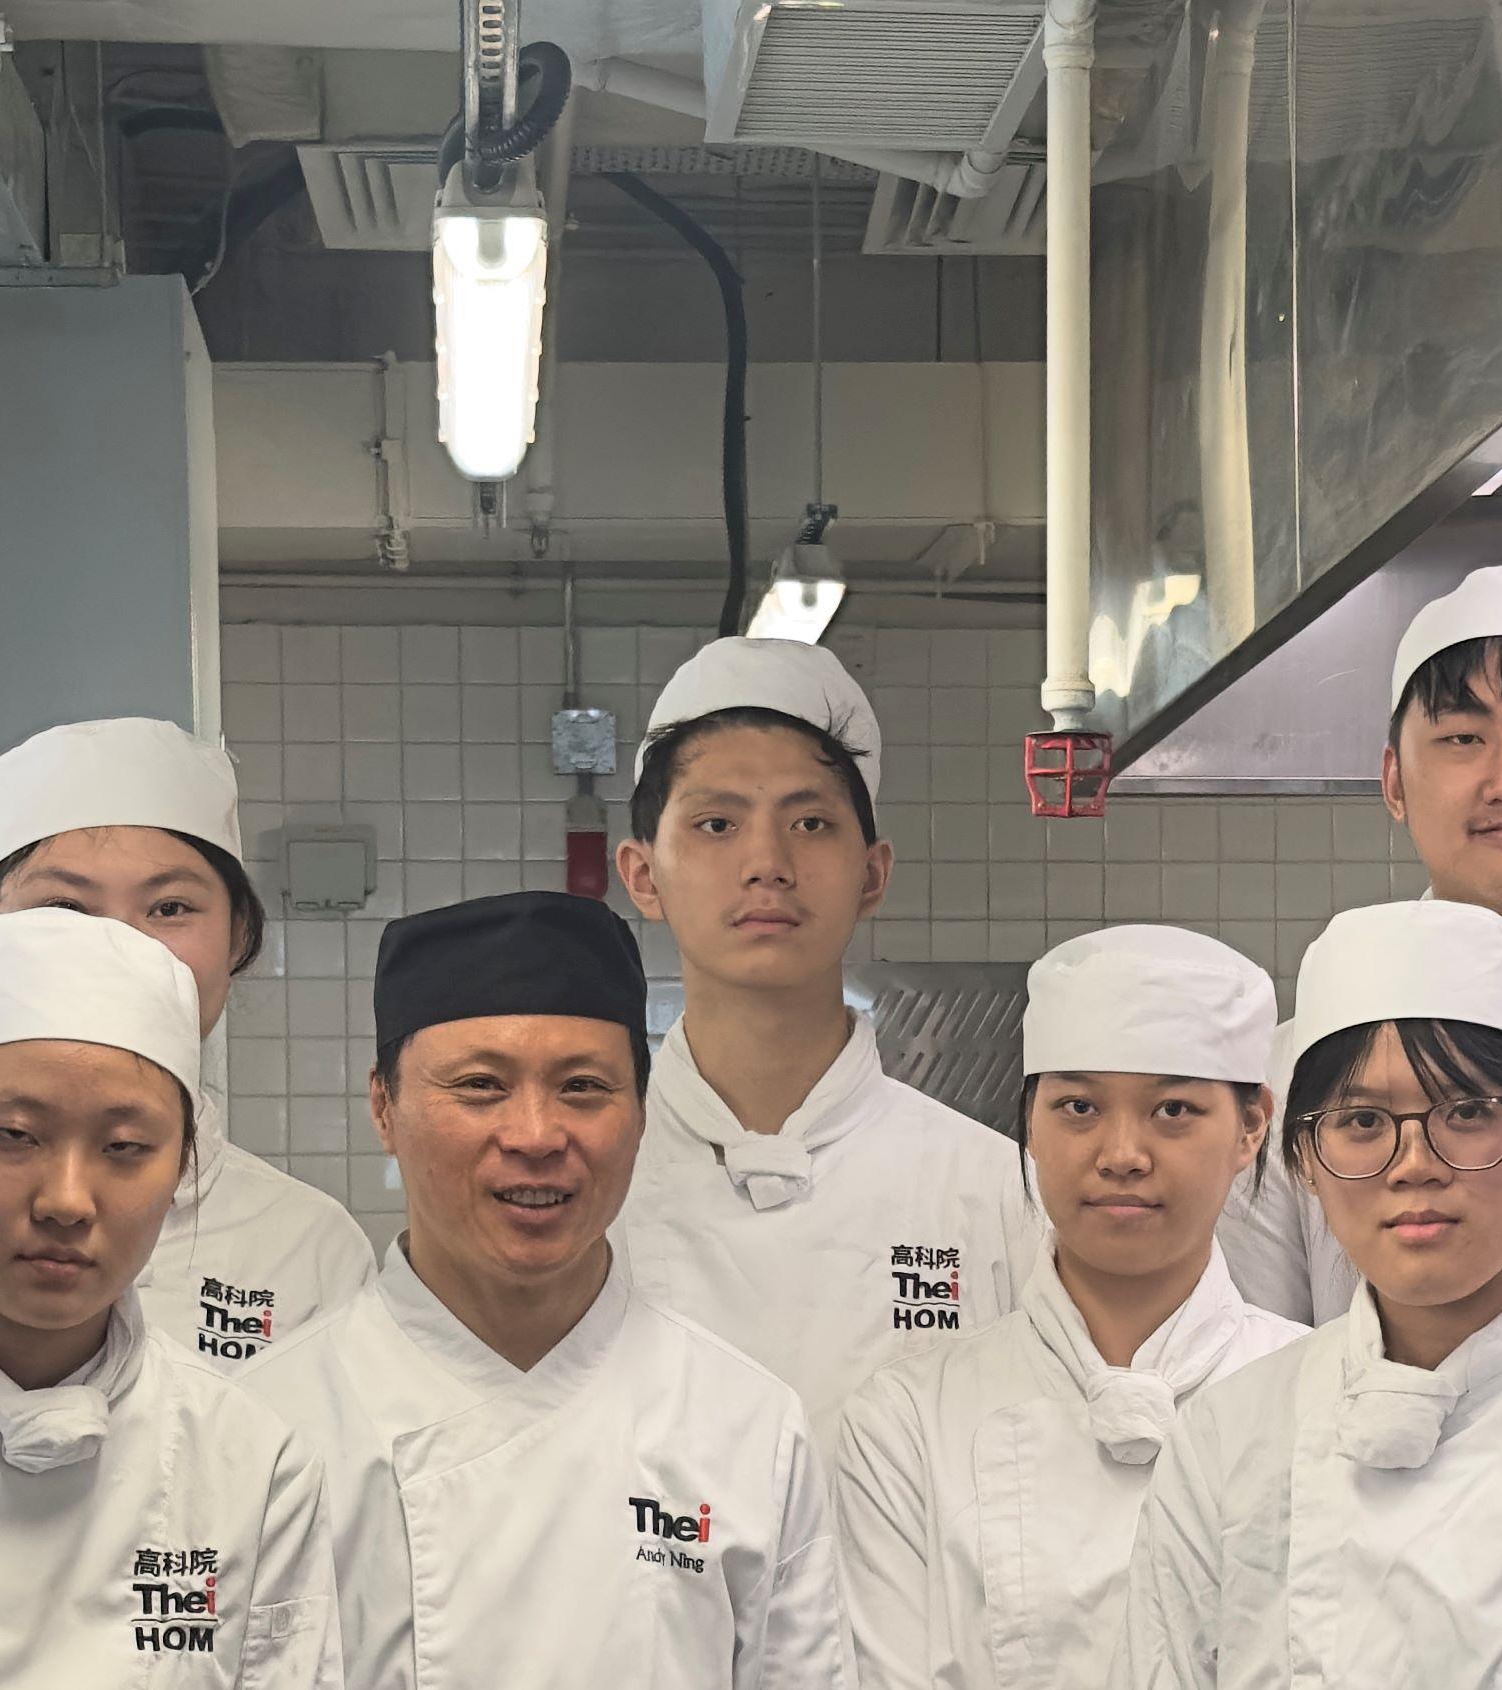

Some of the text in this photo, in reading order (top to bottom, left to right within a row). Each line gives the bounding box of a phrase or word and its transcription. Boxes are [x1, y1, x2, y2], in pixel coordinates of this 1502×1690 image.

[891, 1244, 960, 1270] 高科院
[201, 1277, 274, 1307] 高科院
[892, 1271, 959, 1301] Thei
[200, 1300, 272, 1337] Thei
[894, 1308, 959, 1330] HOM
[628, 1496, 711, 1542] Thei
[134, 1548, 218, 1577] 高科院
[636, 1545, 705, 1573] Andy Ning
[133, 1577, 216, 1615] Thei
[135, 1626, 214, 1652] HOM
